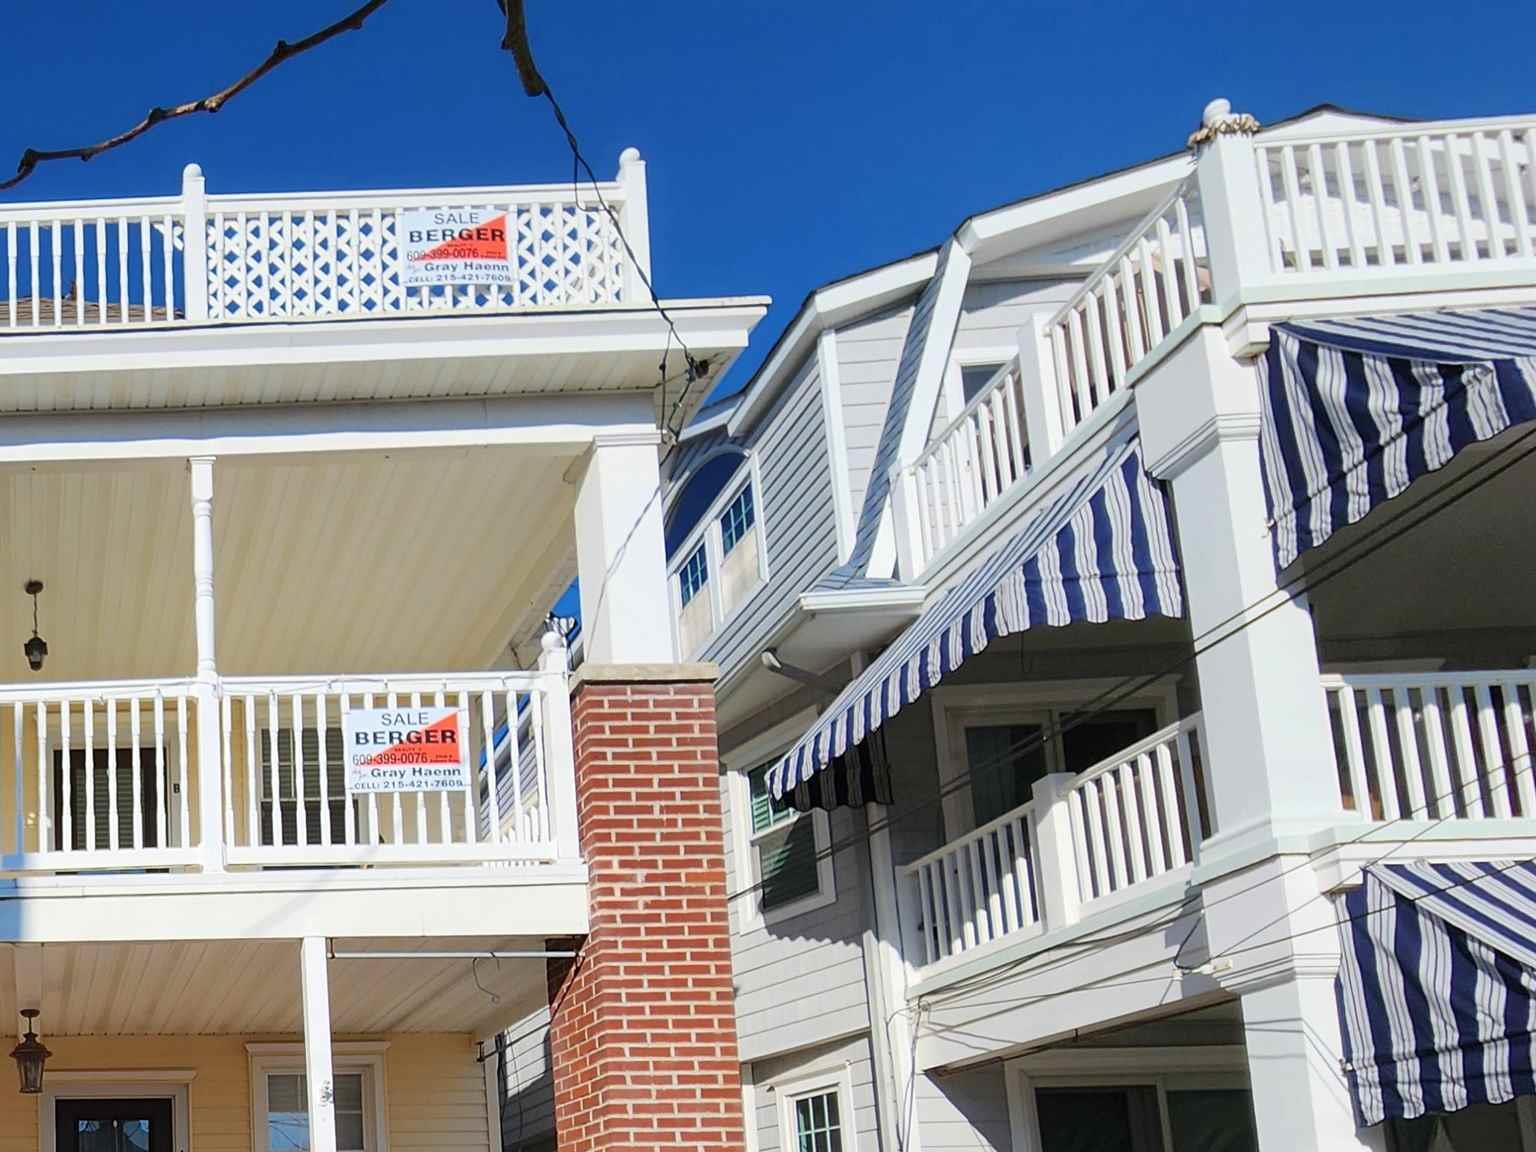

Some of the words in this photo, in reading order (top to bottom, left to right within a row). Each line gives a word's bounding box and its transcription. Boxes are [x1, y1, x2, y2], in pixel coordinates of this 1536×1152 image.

[433, 212, 480, 224] SALE
[409, 228, 505, 243] BERGER
[407, 247, 479, 262] 609-399-0076
[424, 262, 458, 273] Gray
[464, 261, 509, 272] Haenn
[381, 712, 429, 726] SALE
[355, 729, 457, 745] BERGER
[352, 752, 428, 766] 609-399-0076
[370, 767, 406, 779] Gray
[412, 767, 462, 777] Haenn
[173, 783, 180, 793] B
[354, 781, 380, 790] CELL:
[383, 780, 464, 789] 215-421-7609
